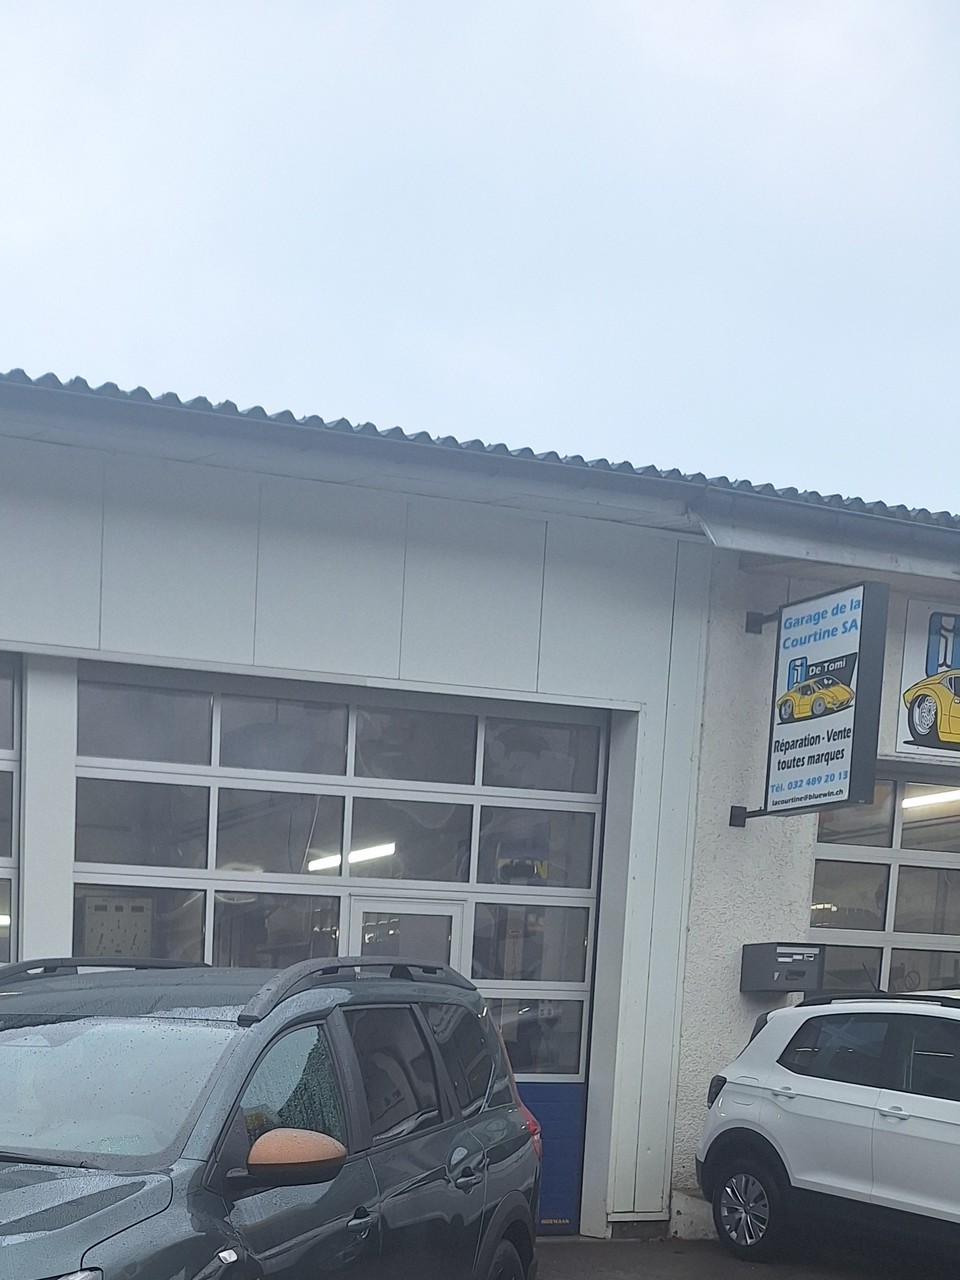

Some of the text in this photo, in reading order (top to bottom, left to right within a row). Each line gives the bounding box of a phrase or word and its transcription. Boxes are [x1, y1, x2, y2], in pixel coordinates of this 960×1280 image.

[784, 598, 861, 629] Garage de la
[782, 618, 859, 650] Courtine SA
[809, 666, 822, 676] De
[773, 733, 821, 755] Réparation
[826, 727, 852, 742] Vente
[777, 748, 845, 771] toutes marques
[787, 779, 803, 790] 032
[805, 775, 823, 787] 489
[824, 773, 835, 783] 20
[838, 770, 849, 781] 13
